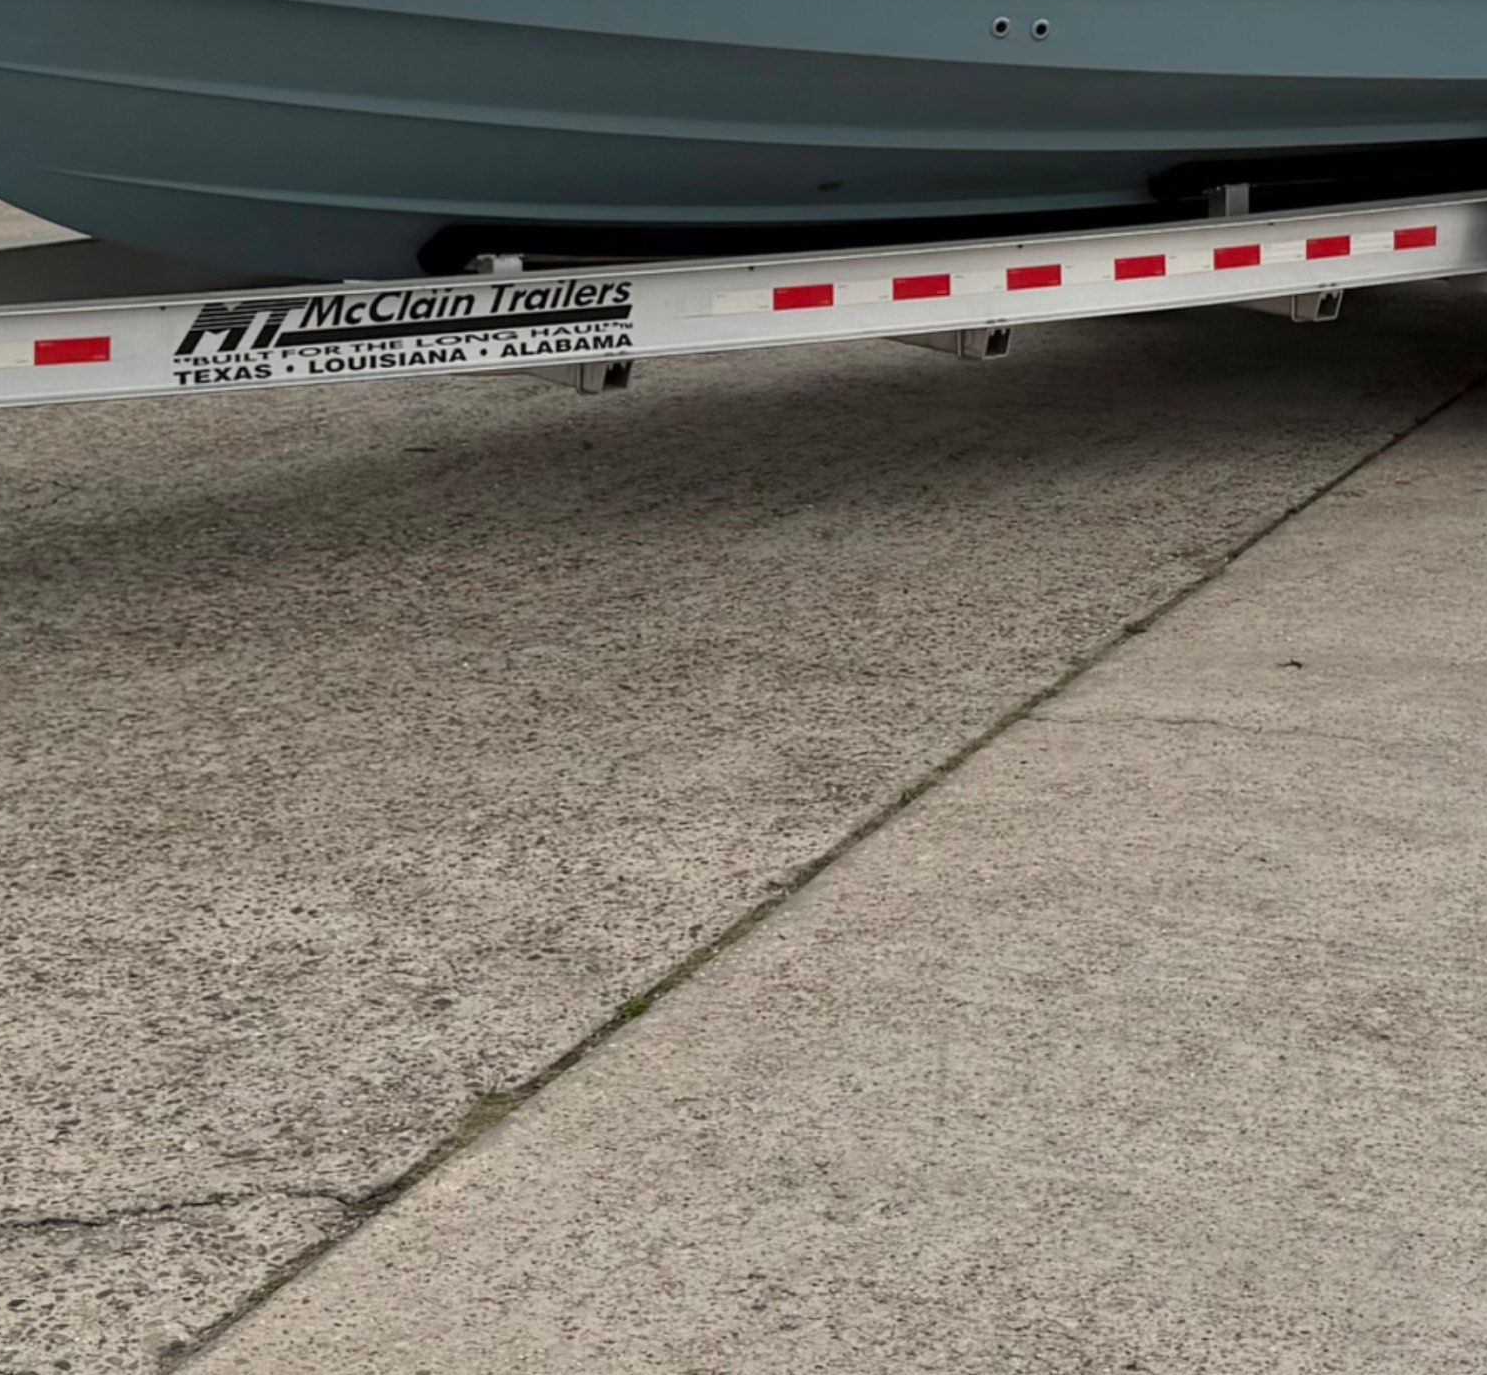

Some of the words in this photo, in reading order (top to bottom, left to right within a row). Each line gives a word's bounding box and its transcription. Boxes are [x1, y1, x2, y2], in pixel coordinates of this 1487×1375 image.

[174, 297, 309, 356] MT
[298, 288, 475, 329] McClain
[490, 280, 632, 314] Trailers
[173, 363, 272, 386] TEXAS
[309, 348, 467, 375] LOUISIANA
[500, 333, 632, 358] ALABAMA
[282, 345, 341, 359] FOR
[350, 340, 403, 353] THE
[416, 330, 518, 349] LONG
